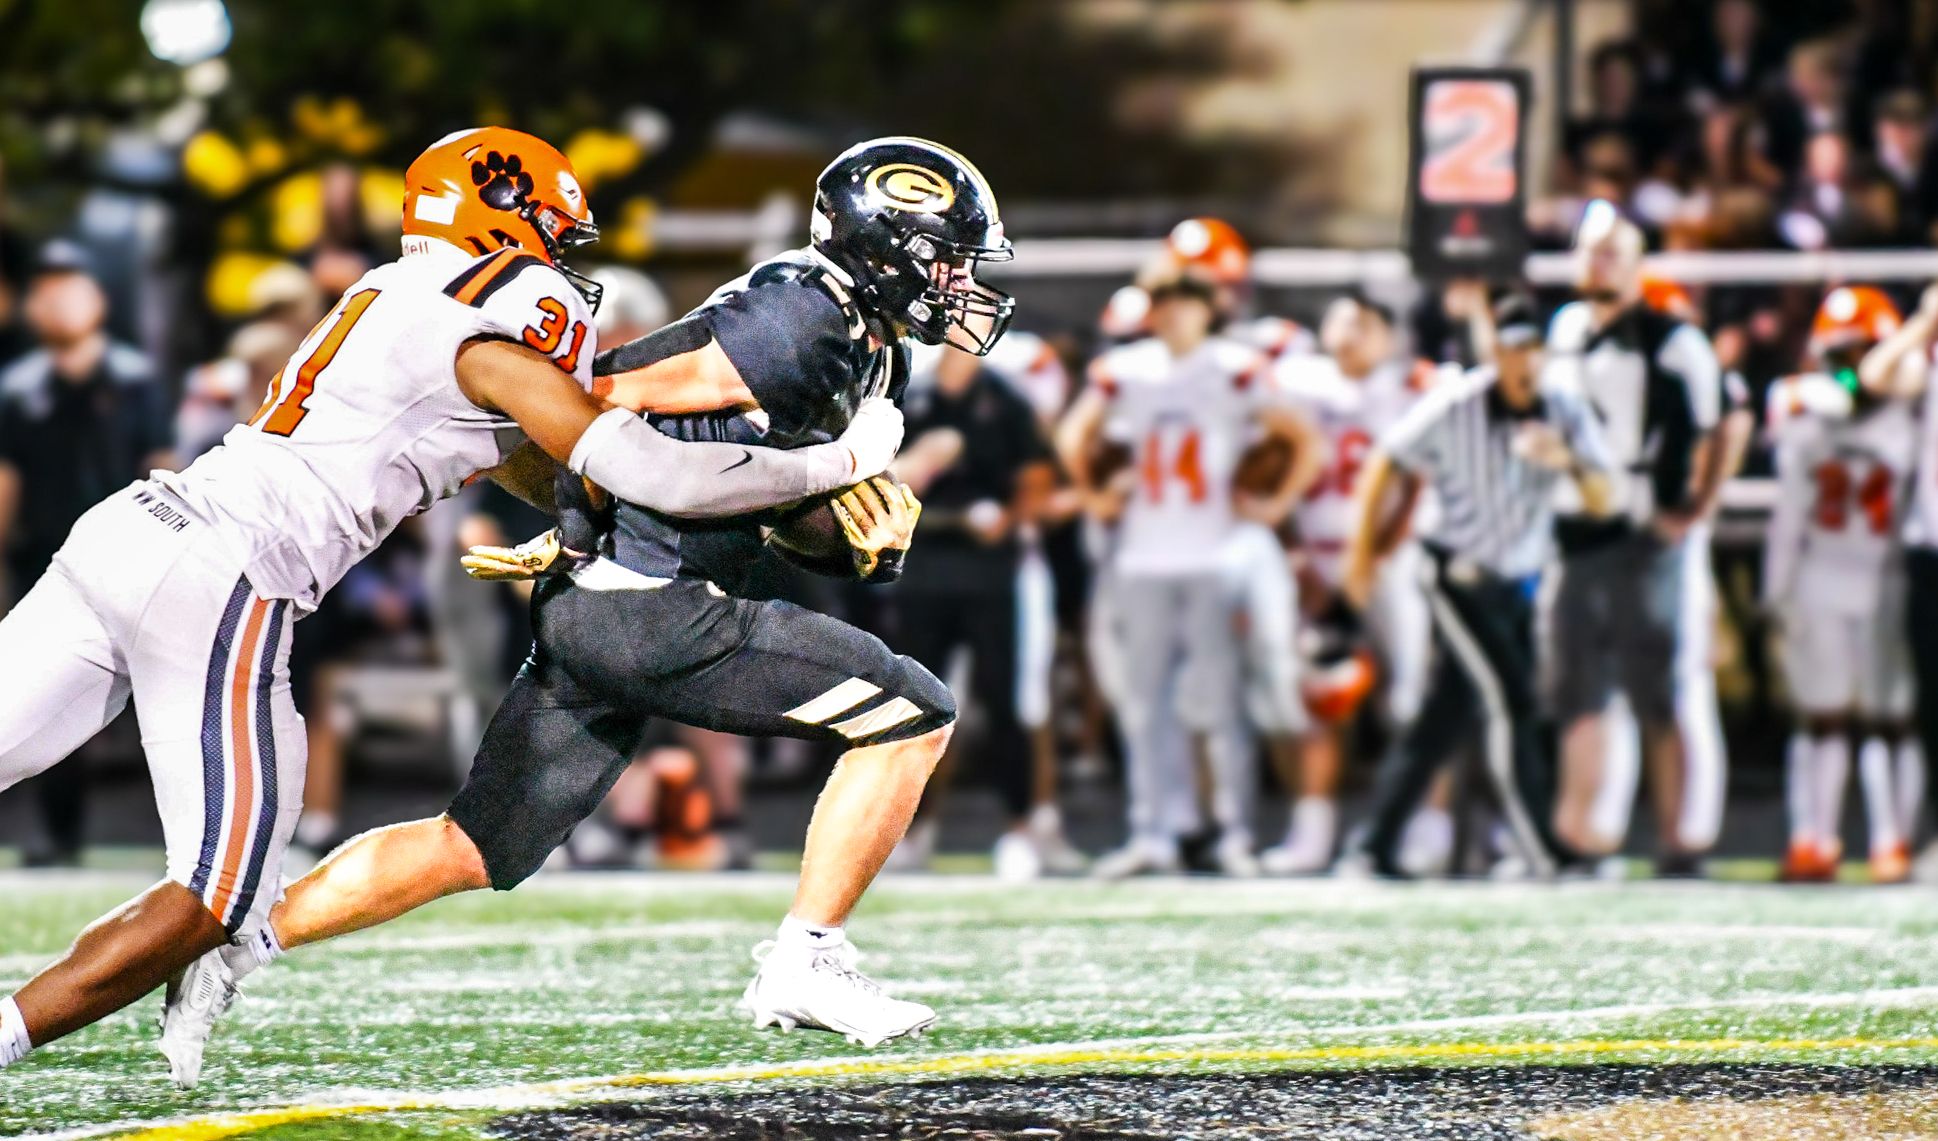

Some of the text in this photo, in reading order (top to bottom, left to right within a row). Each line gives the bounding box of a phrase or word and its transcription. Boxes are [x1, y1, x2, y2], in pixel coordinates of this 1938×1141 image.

[1421, 80, 1518, 204] 2
[865, 163, 955, 214] G
[522, 296, 587, 374] 31
[147, 502, 191, 533] SOUTH
